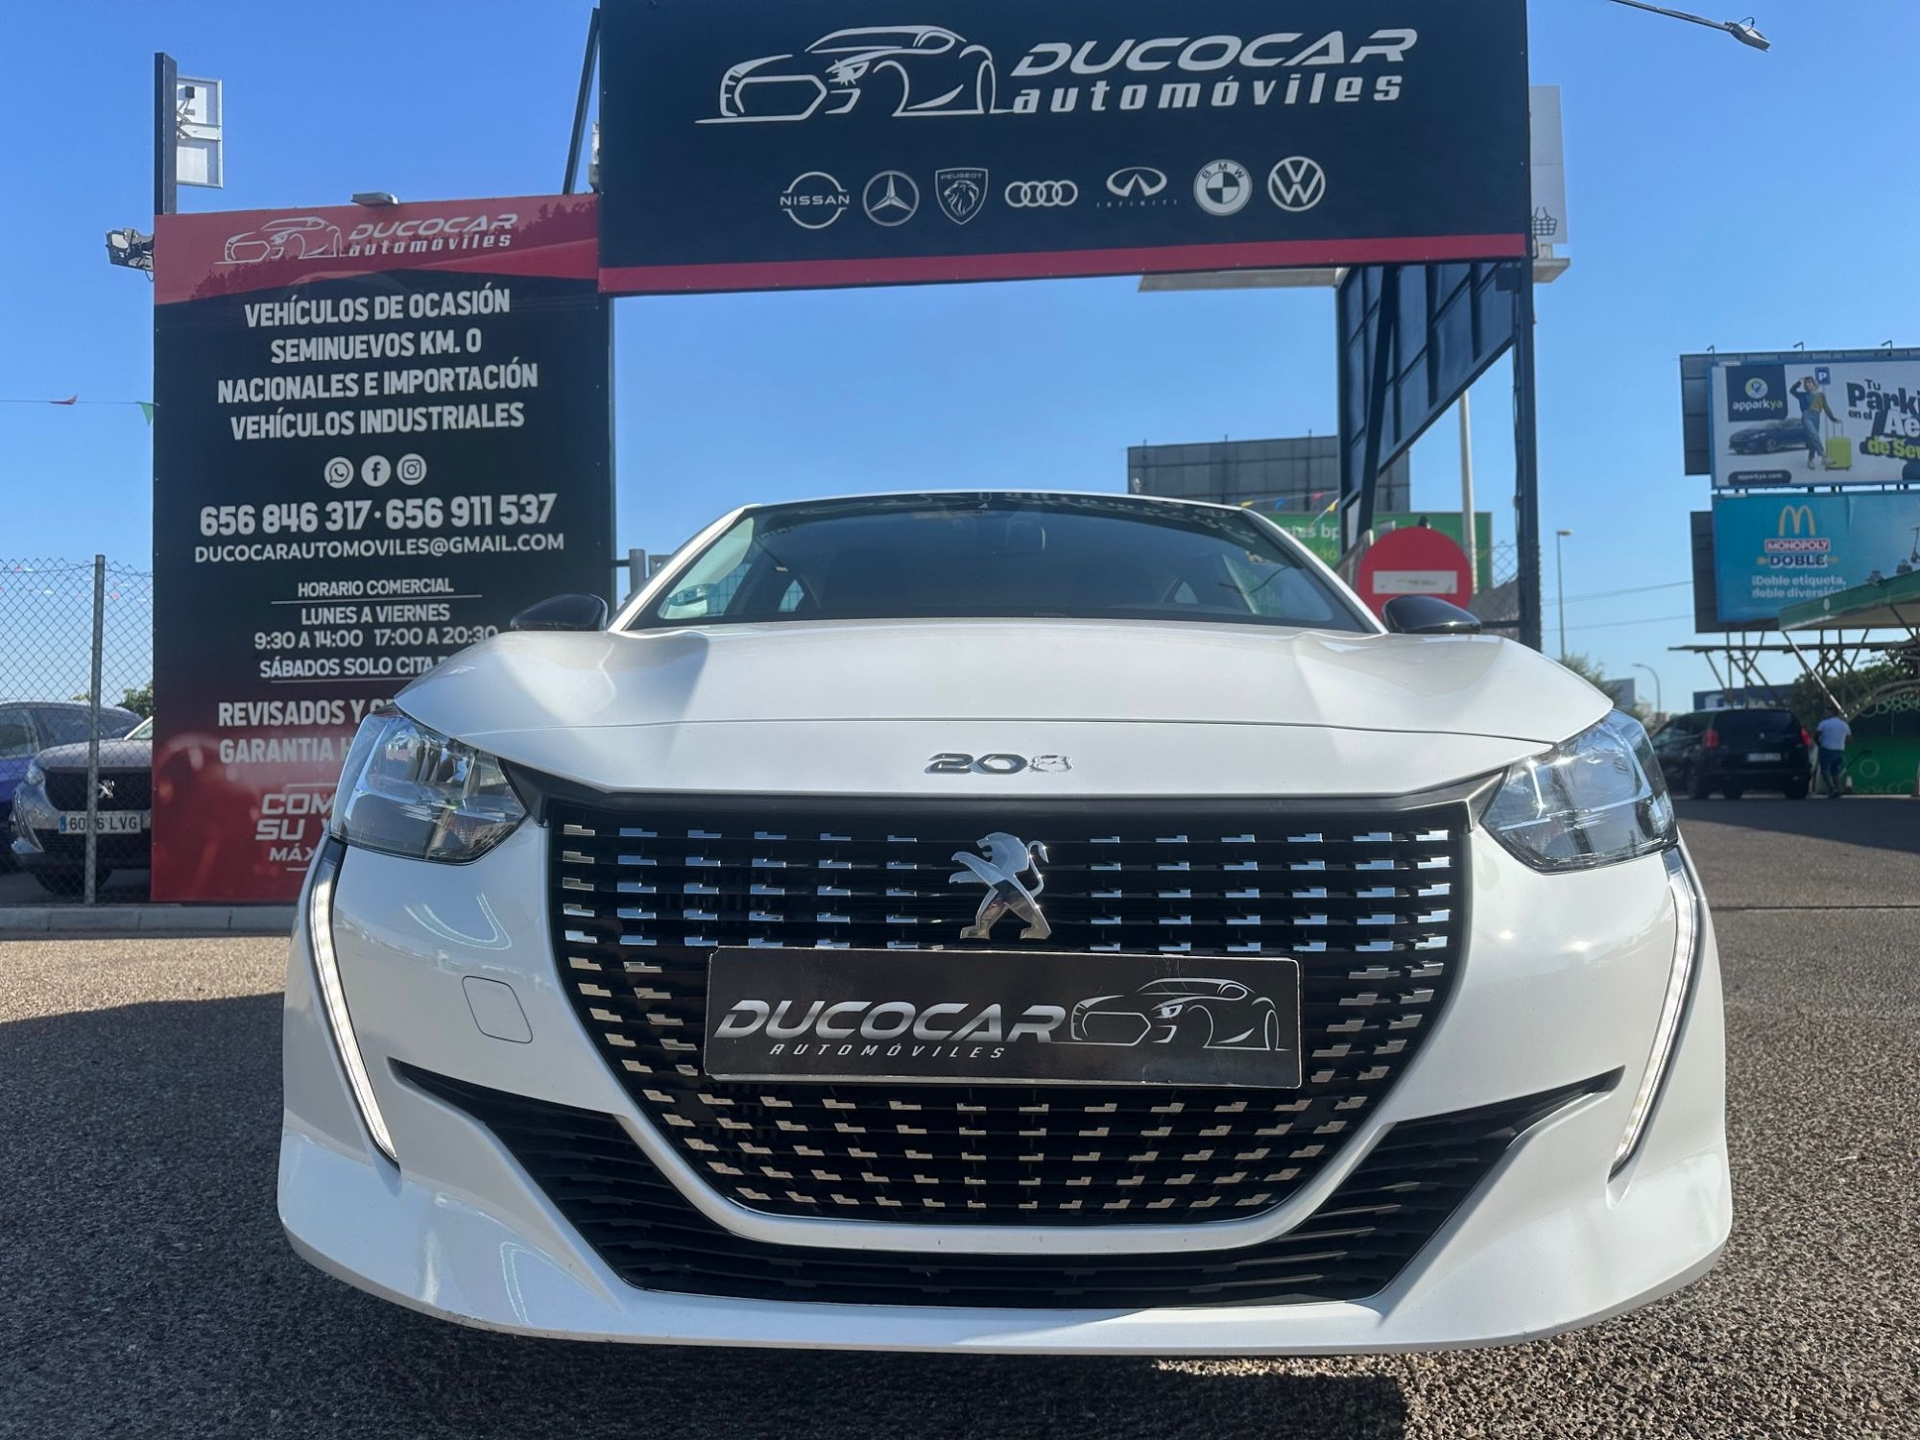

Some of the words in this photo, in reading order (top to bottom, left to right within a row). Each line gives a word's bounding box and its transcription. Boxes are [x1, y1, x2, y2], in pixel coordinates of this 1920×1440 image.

[1010, 28, 1418, 77] DUCOCAR
[1013, 71, 1404, 114] automóviles
[940, 172, 983, 181] PEUGEOT
[780, 194, 850, 207] NISSAN
[349, 213, 519, 241] DUCOCAR
[349, 232, 512, 257] automóviles
[245, 295, 369, 327] VEHÍCULOS
[374, 295, 404, 320] DE
[409, 282, 510, 318] OCASIÓN
[271, 332, 414, 364] SEMINUEVOS
[420, 330, 460, 355] KM.
[218, 372, 359, 403] NACIONALES
[364, 372, 378, 396] E
[384, 357, 538, 396] IMPORTACIÓN
[1864, 378, 1881, 391] Tu
[1732, 399, 1783, 412] apparkya
[231, 408, 354, 440] VEHÍCULOS
[360, 402, 525, 434] INDUSTRIALES
[1867, 435, 1890, 455] de
[200, 504, 255, 537] 656
[262, 502, 318, 534] 846
[451, 495, 493, 527] 911
[500, 493, 557, 525] 537
[195, 533, 564, 563] DUCOCARAUTOMOVILES@GMAIL.COM
[1767, 540, 1829, 552] MONOPOLY
[1769, 554, 1828, 568] DOBLE
[298, 580, 364, 598] HORARIO
[367, 577, 454, 594] COMERCIAL
[302, 606, 357, 626] LUNES
[360, 606, 373, 624] A
[376, 603, 450, 622] VIERNES
[254, 631, 295, 650] 9:30
[298, 631, 311, 649] A
[314, 629, 364, 648] 14:00
[374, 627, 423, 646] 17:00
[426, 627, 439, 644] A
[260, 656, 340, 678] SÁBADOS
[344, 657, 392, 676] SOLO
[396, 656, 433, 675] CITA
[218, 699, 345, 727] REVISADOS
[350, 699, 365, 724] Y
[219, 737, 335, 764] GARANTIA
[924, 752, 1074, 775] 208
[69, 817, 104, 831] 606
[109, 816, 137, 831] LVG
[255, 818, 305, 841] SU
[713, 999, 1067, 1043] DUCOCAR
[769, 1042, 1006, 1060] AUTOMÓVILES
